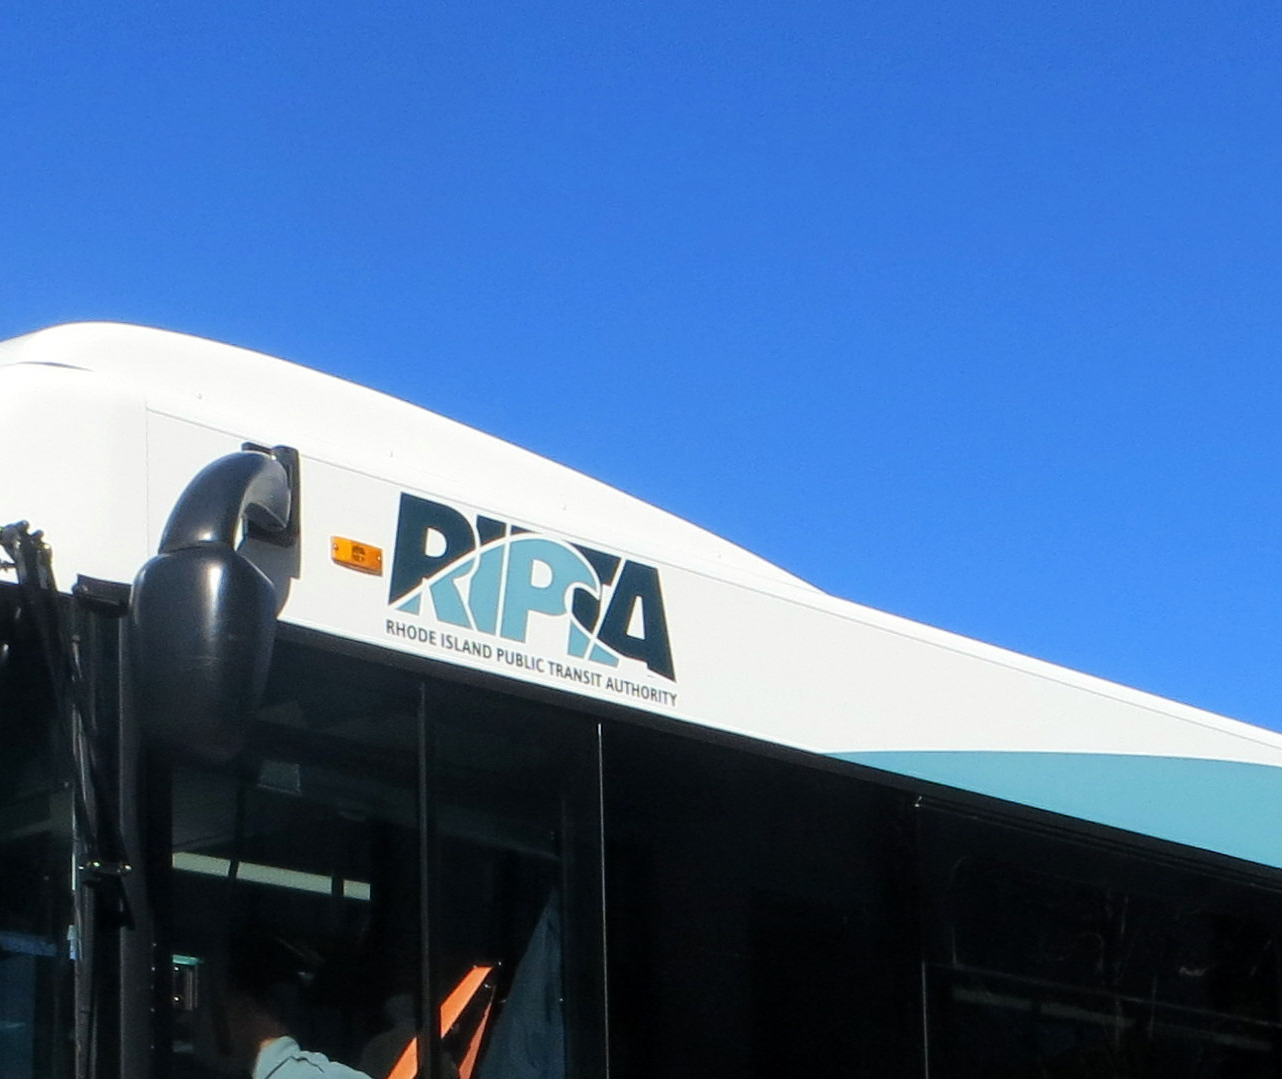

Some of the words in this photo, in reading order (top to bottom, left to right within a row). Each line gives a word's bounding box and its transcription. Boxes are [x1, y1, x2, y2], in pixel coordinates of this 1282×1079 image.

[388, 492, 677, 683] RIPTA
[385, 619, 437, 646] RHODE
[441, 632, 492, 659] ISLAND
[497, 647, 545, 674] PUBLIC
[548, 660, 602, 688] TRANSIT
[606, 677, 677, 707] AUTHORITY
